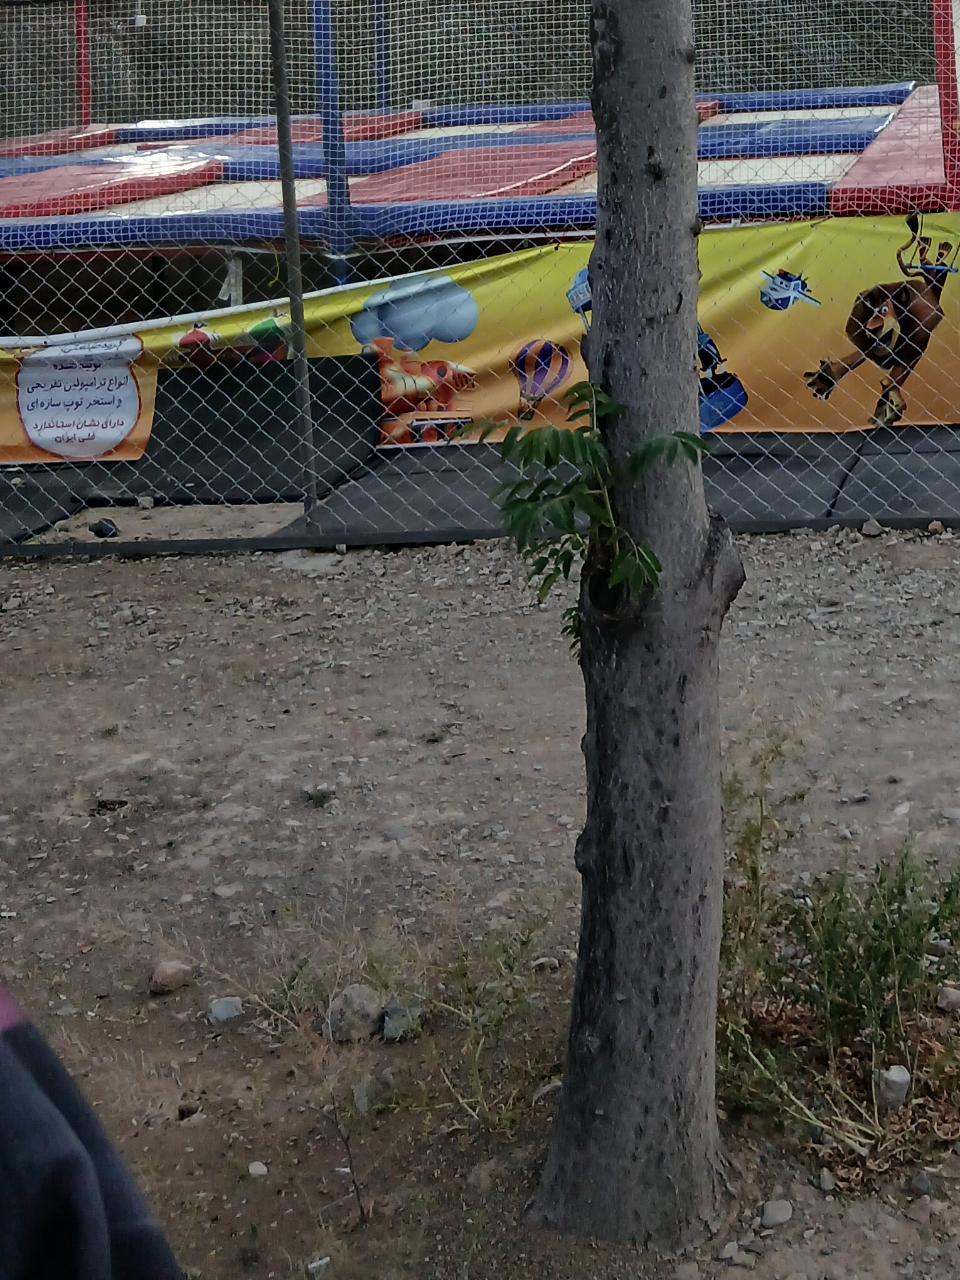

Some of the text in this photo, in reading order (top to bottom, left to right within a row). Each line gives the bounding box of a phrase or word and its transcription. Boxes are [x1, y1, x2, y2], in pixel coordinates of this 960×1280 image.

[26, 375, 129, 394] انواع ترامپولین تفریحی
[63, 397, 83, 412] توپ
[86, 395, 116, 409] استخر
[33, 417, 124, 432] دارای نشان استاندارد
[54, 432, 77, 444] ایران
